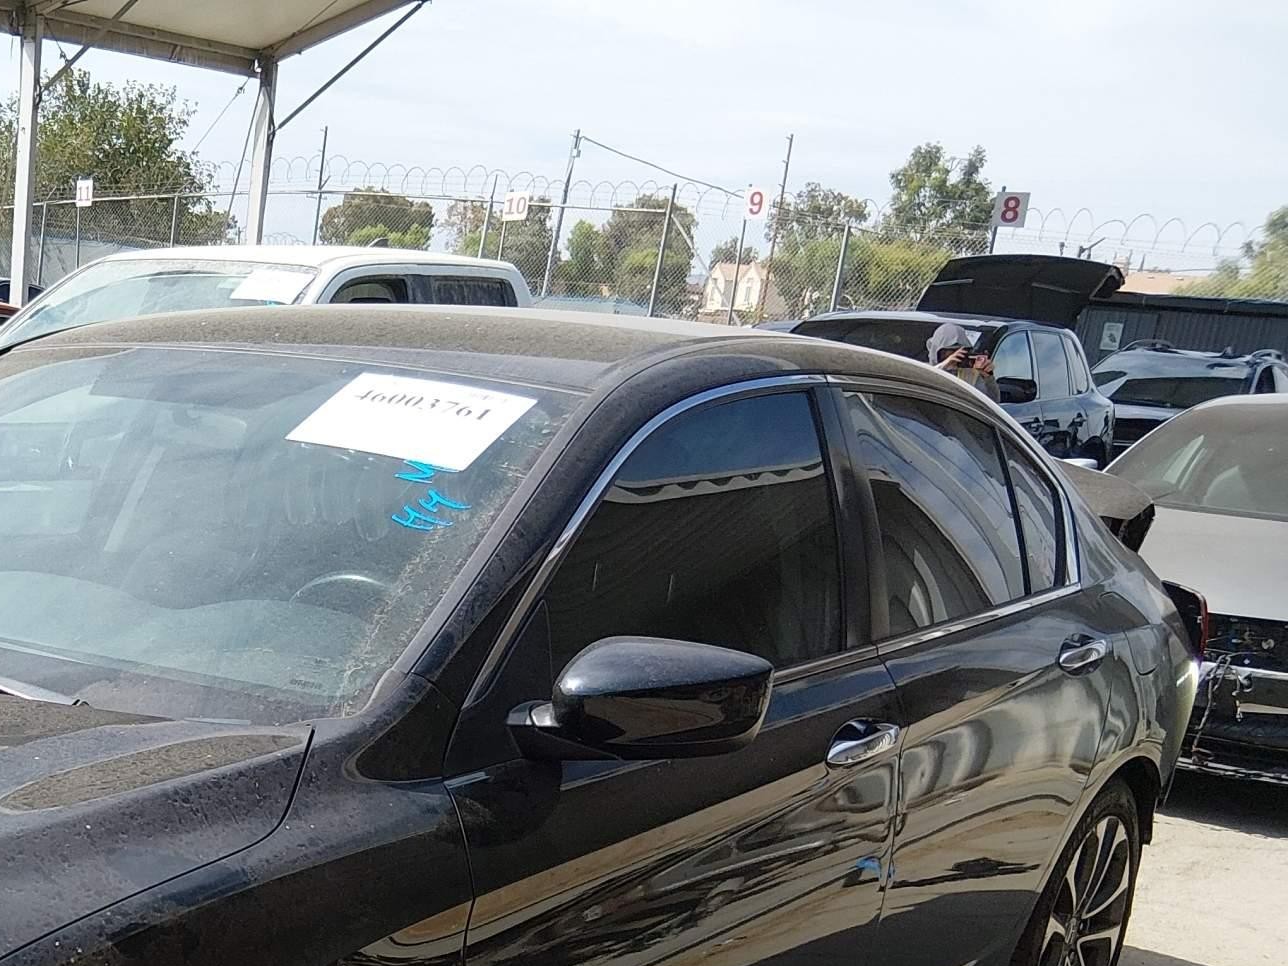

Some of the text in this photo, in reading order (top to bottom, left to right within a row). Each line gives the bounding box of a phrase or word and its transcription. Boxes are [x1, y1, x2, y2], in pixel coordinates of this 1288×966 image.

[78, 186, 91, 202] 11
[505, 196, 527, 215] 10
[749, 191, 764, 216] 9
[1000, 196, 1021, 223] 8
[354, 390, 491, 420] 46003761
